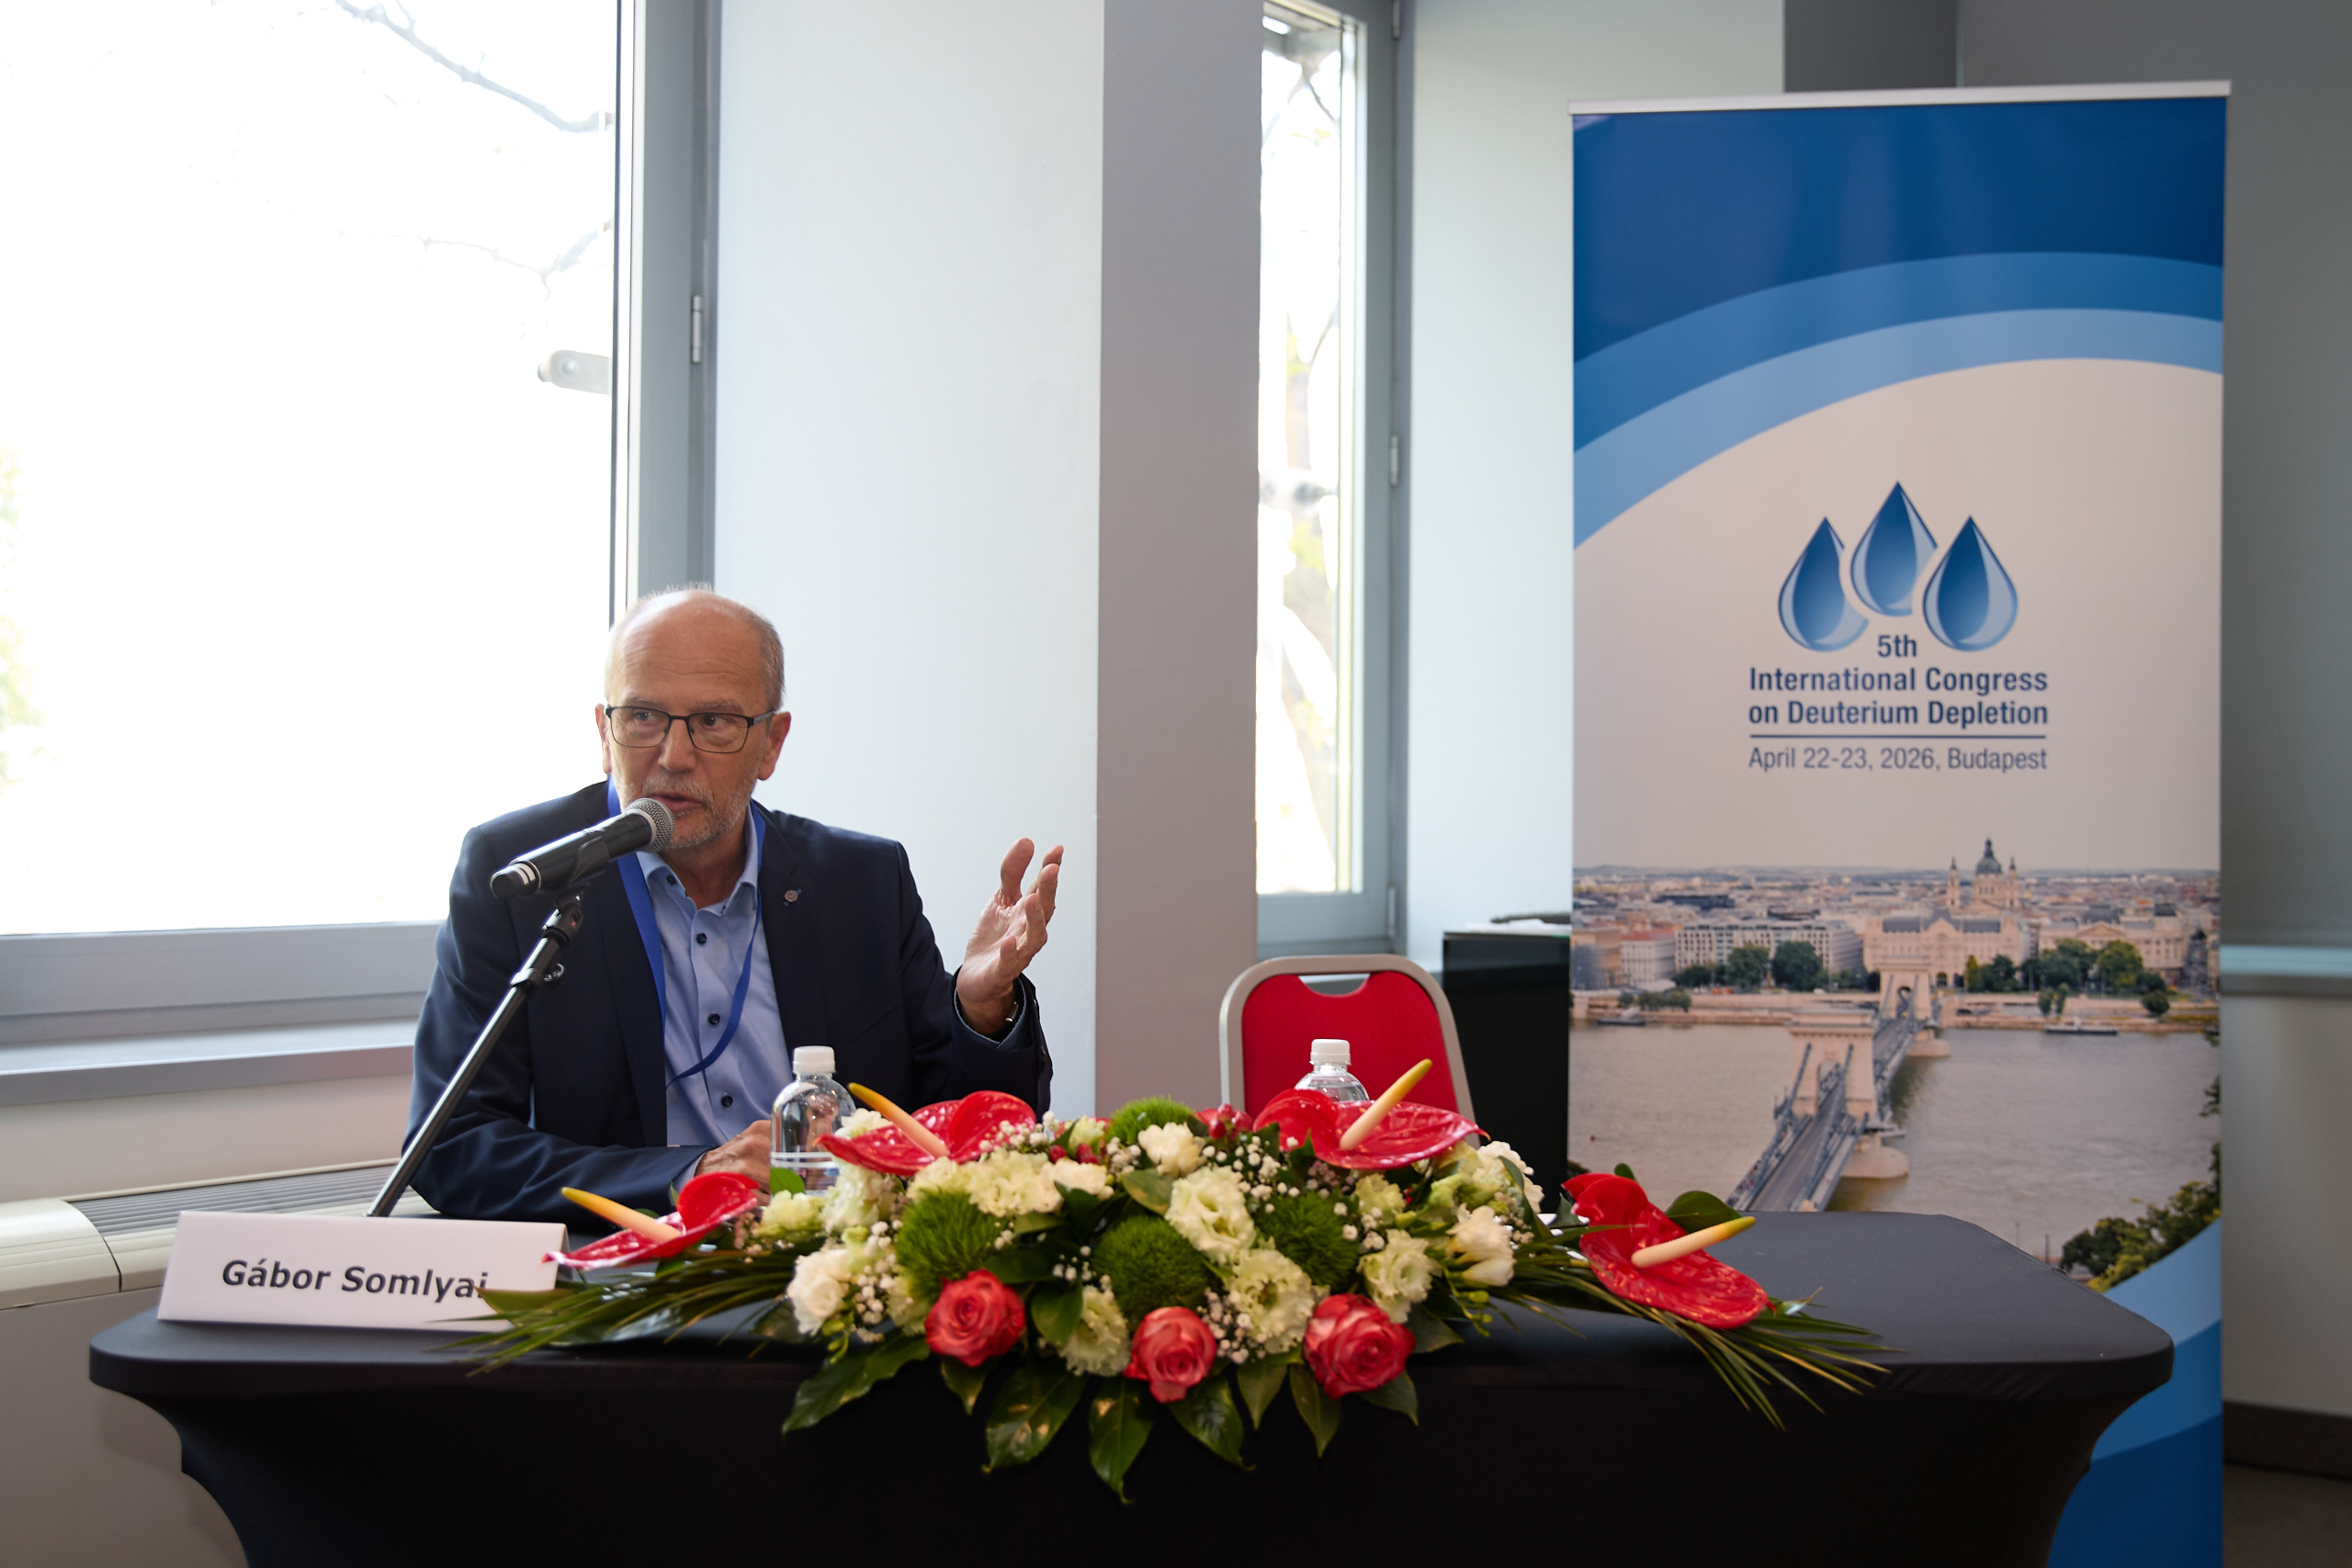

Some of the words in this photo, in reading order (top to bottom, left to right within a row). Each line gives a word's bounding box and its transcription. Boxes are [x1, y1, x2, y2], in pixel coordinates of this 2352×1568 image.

[1877, 634, 1917, 658] 5th
[1750, 667, 1916, 692] International
[1925, 667, 2048, 696] Congress
[1748, 705, 1779, 725] on
[1788, 700, 1918, 725] Deuterium
[1928, 701, 2048, 729] Depletion
[1748, 747, 1796, 773] April
[1803, 747, 1873, 772] 22-23,
[1880, 747, 1940, 772] 2026,
[1948, 748, 2048, 773] Budapest
[221, 1258, 331, 1291] Gábor
[341, 1265, 488, 1303] Somlyai
